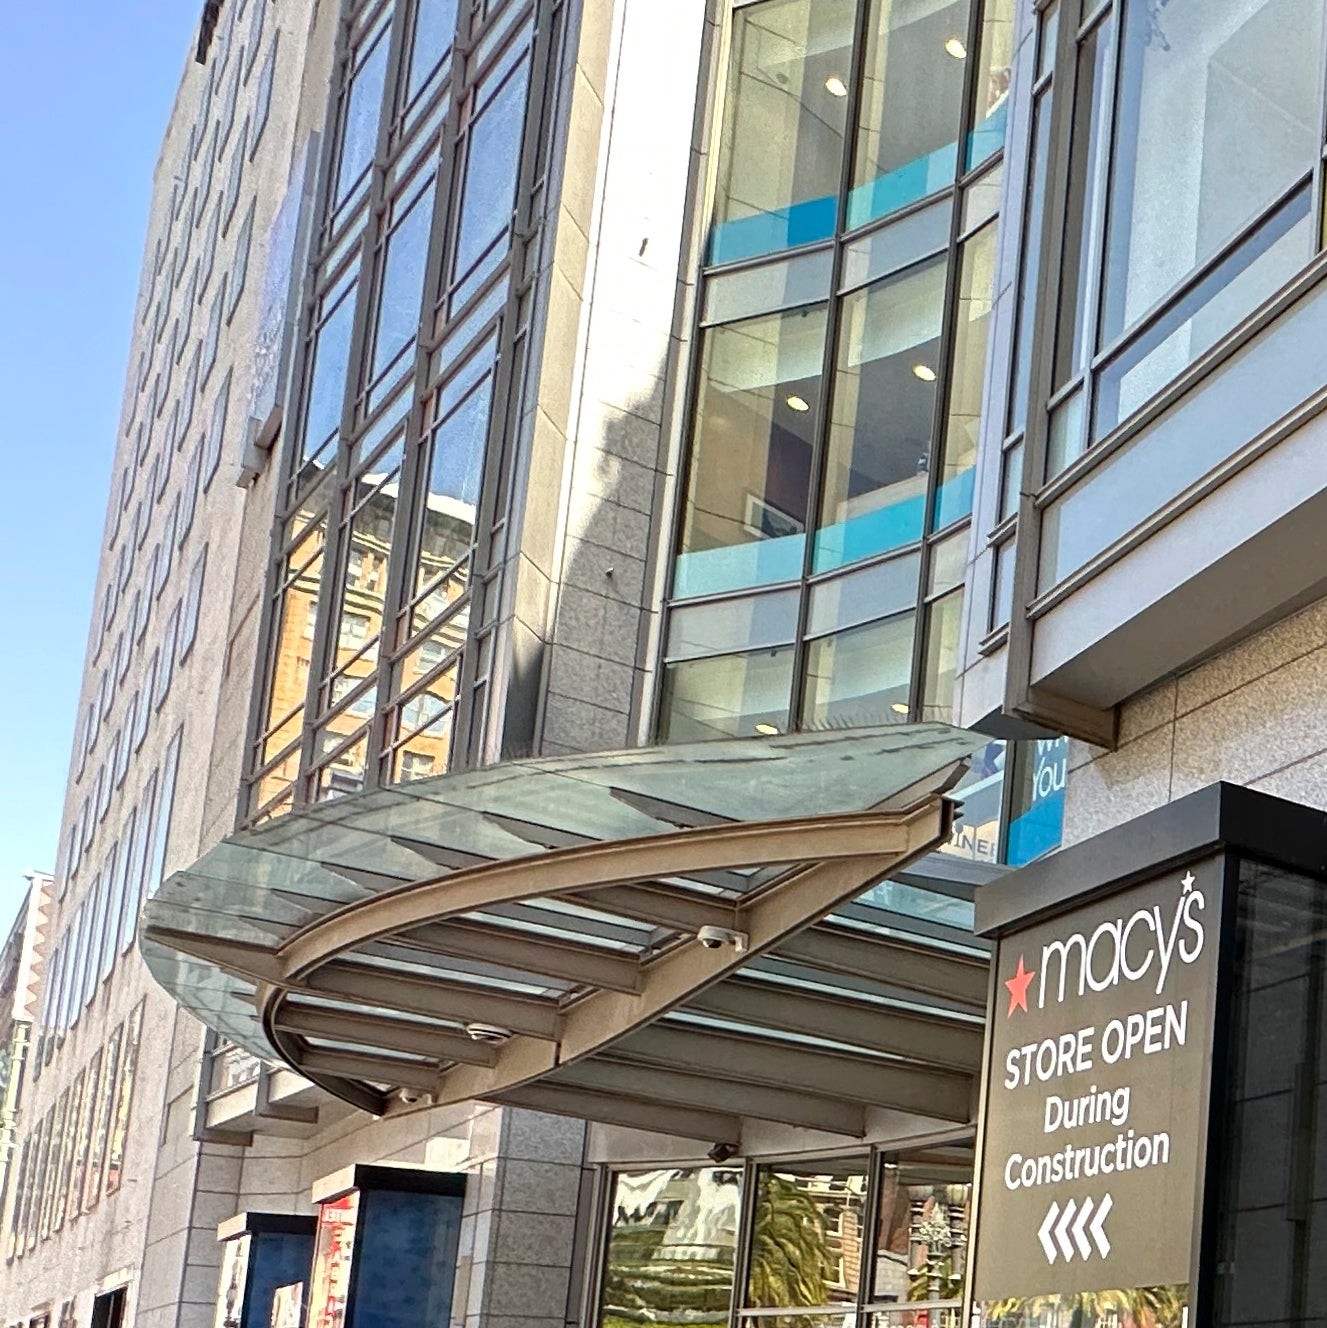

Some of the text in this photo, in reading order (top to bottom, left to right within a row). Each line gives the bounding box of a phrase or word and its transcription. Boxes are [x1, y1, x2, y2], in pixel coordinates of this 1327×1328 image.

[1032, 757, 1067, 801] You
[1037, 869, 1206, 1009] macy's
[1004, 1000, 1190, 1092] STORE OPEN
[1043, 1084, 1131, 1133] During
[1004, 1130, 1171, 1191] Construction
